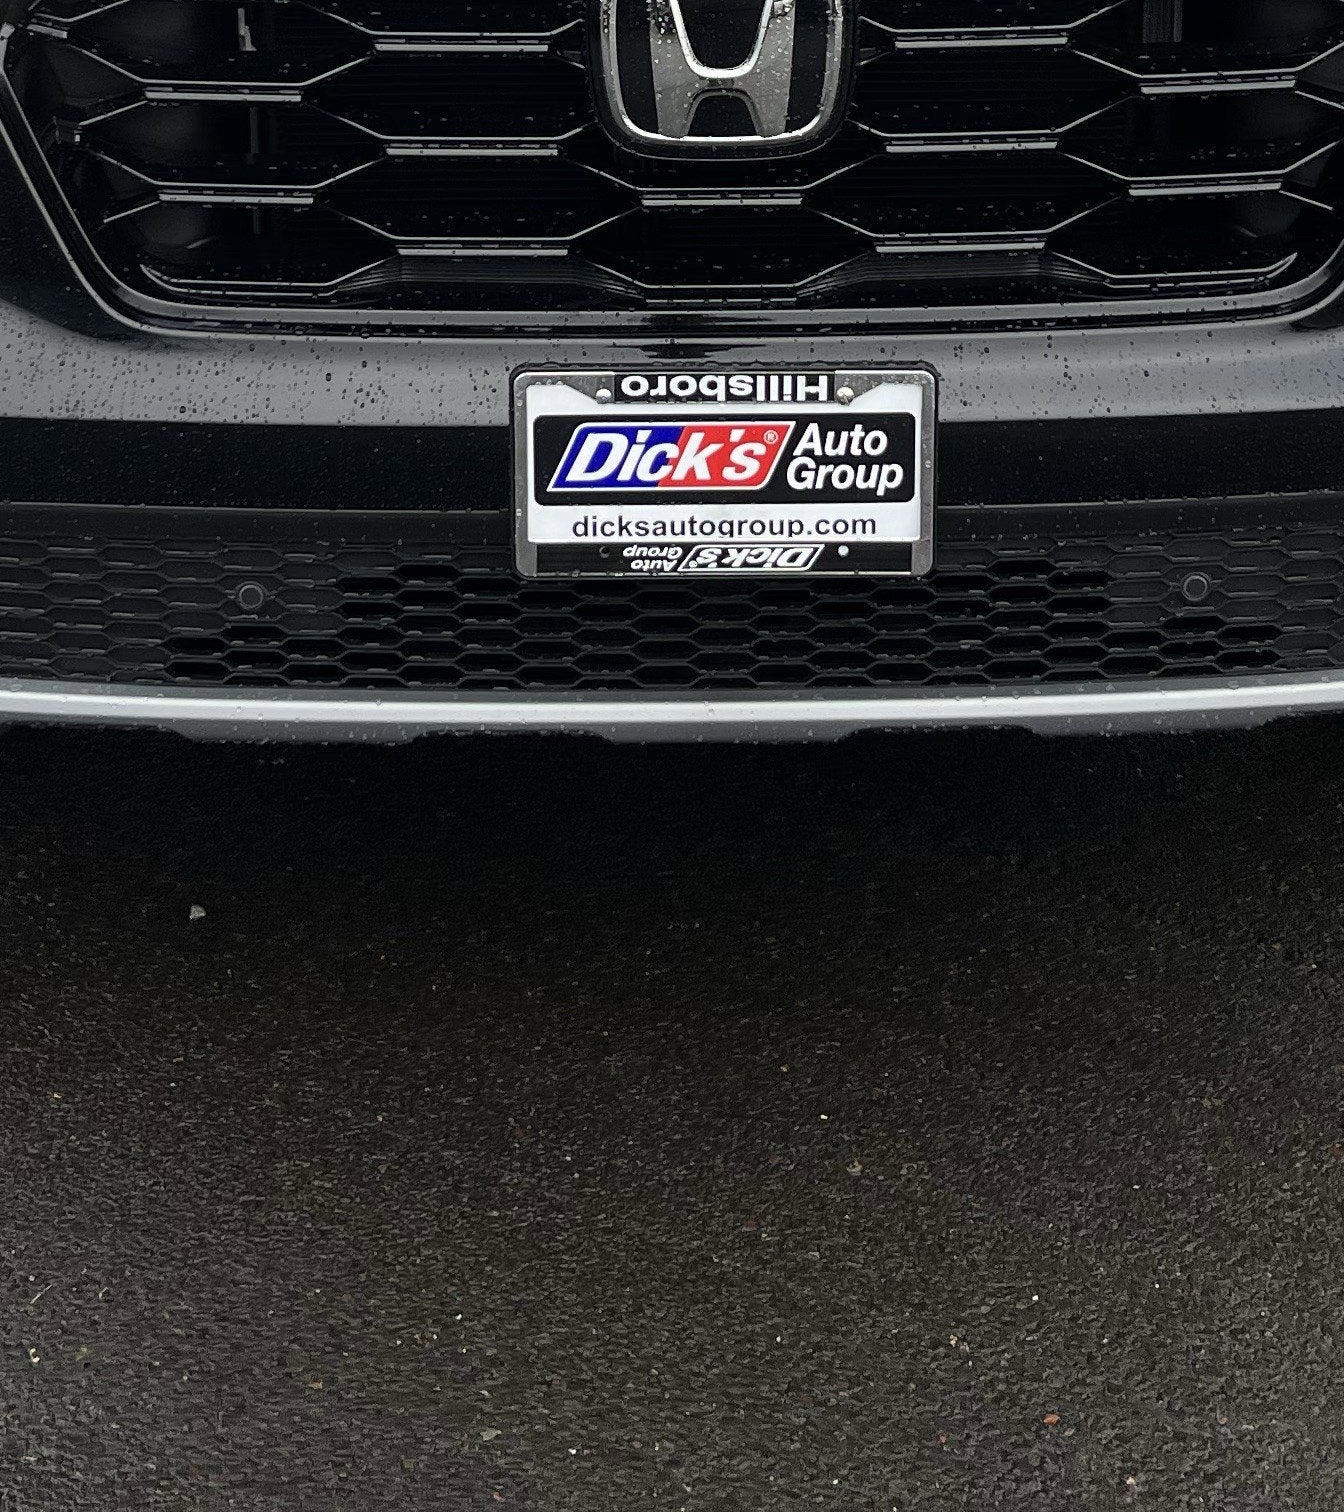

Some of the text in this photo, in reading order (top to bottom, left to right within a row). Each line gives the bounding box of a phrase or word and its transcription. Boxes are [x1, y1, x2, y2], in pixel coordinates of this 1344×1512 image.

[620, 374, 828, 402] Hillsboro
[792, 422, 888, 457] Auto
[564, 429, 767, 483] Dick's
[786, 456, 904, 497] Group
[572, 515, 877, 538] dicksautogroup.com
[622, 544, 683, 560] Group
[630, 559, 678, 572] Auto
